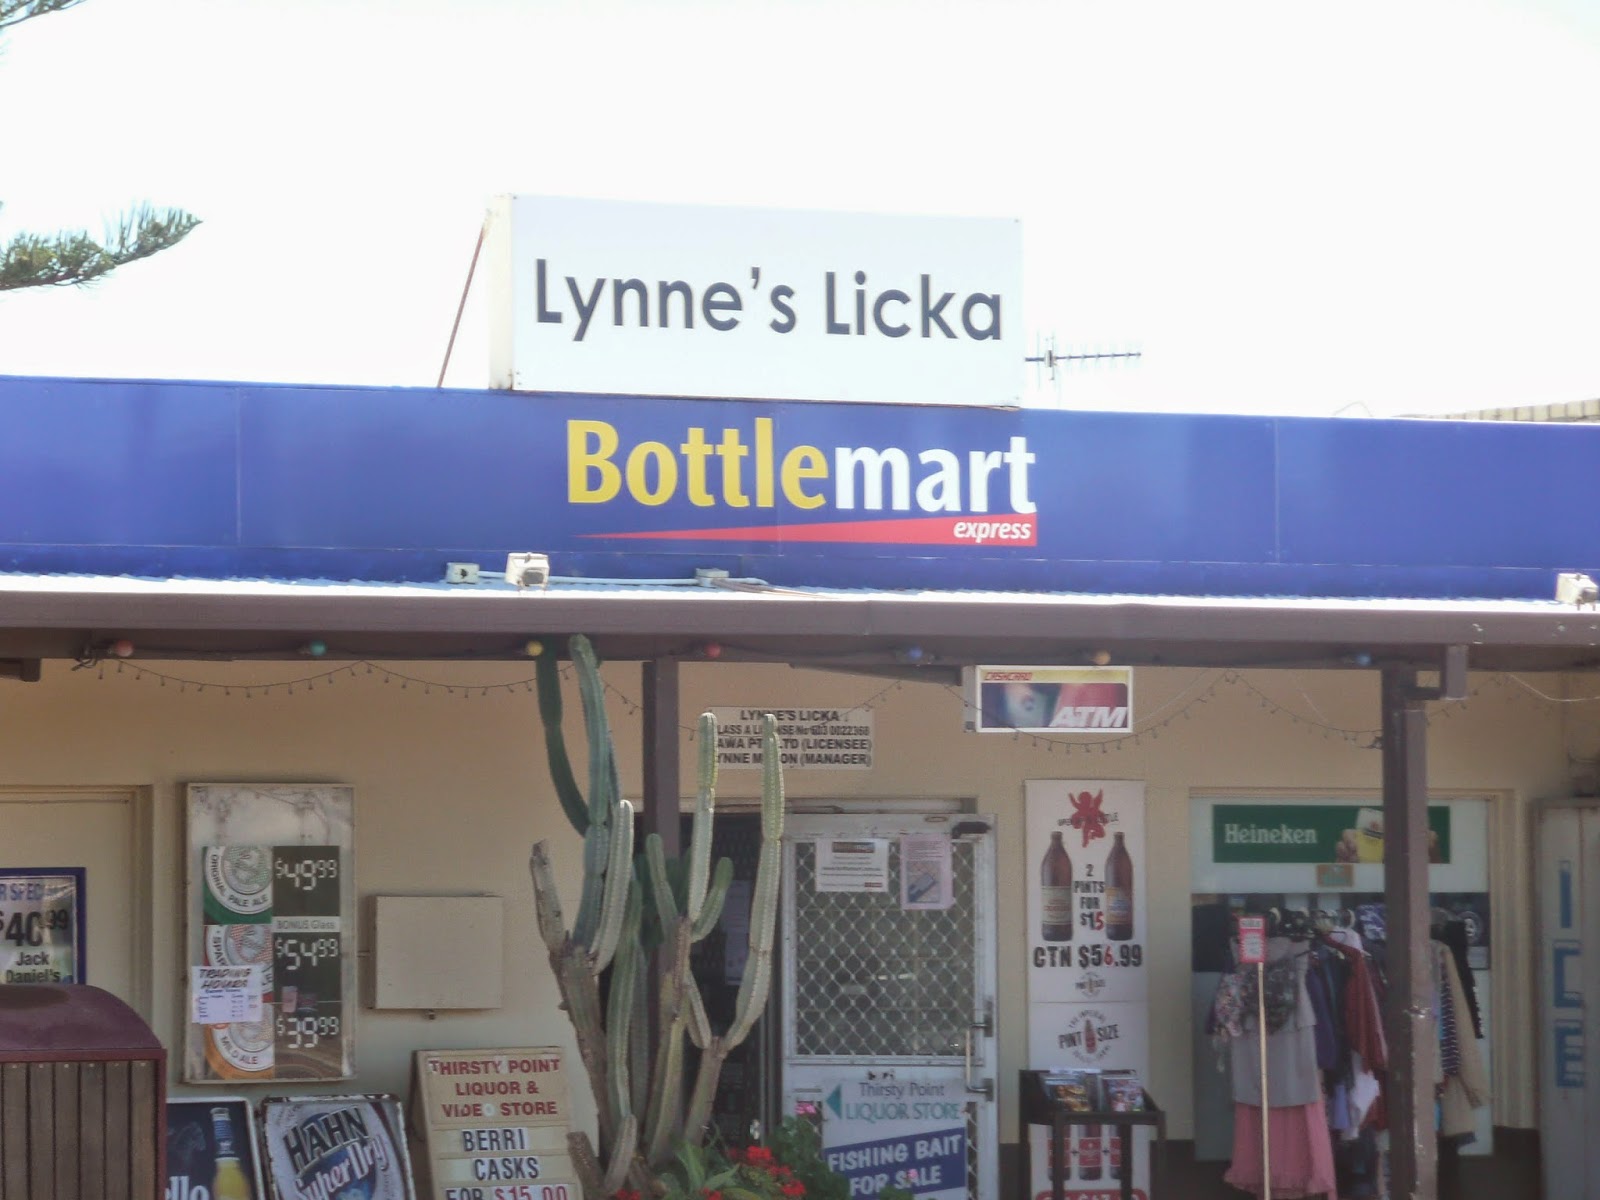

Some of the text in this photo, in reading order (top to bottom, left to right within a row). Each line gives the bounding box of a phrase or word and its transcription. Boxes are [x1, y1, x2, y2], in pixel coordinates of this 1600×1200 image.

[536, 259, 1002, 341] Lynne's Licka
[567, 417, 1037, 513] Bottlemart
[953, 519, 1032, 543] express
[800, 710, 839, 721] LICKA
[1049, 706, 1128, 728] ATM
[717, 725, 742, 735] LASS
[744, 725, 751, 735] A
[718, 738, 744, 749] AWA
[779, 738, 799, 749] TD
[802, 738, 872, 751] (LICENSEE)
[717, 754, 749, 764] YNNE
[801, 754, 872, 766] (MANAGER)
[1224, 823, 1318, 844] Heineken
[1085, 863, 1094, 877] 2
[1074, 880, 1105, 893] PINTS
[228, 893, 250, 908] PALE
[1079, 896, 1100, 910] FOR
[1079, 911, 1105, 931] $15
[16, 951, 50, 967] Jack
[1033, 944, 1143, 968] CTN $56.99
[6, 969, 61, 984] Daniel's
[1058, 1024, 1120, 1050] PINT SIZE
[240, 1055, 258, 1065] ALE
[428, 1058, 561, 1075] THIRSTY POINT
[456, 1081, 539, 1096] LIQUOR &
[858, 1082, 945, 1099] Thirsty Point
[500, 1101, 558, 1117] STORE
[846, 1102, 960, 1123] LIQUOR STORE
[283, 1106, 369, 1173] HAHN
[462, 1129, 525, 1151] BERRI
[347, 1134, 388, 1180] Dry
[828, 1134, 962, 1172] FISHING BAIT
[474, 1157, 540, 1181] CASKS
[494, 1185, 567, 1200] $1500
[851, 1173, 890, 1196] FOR
